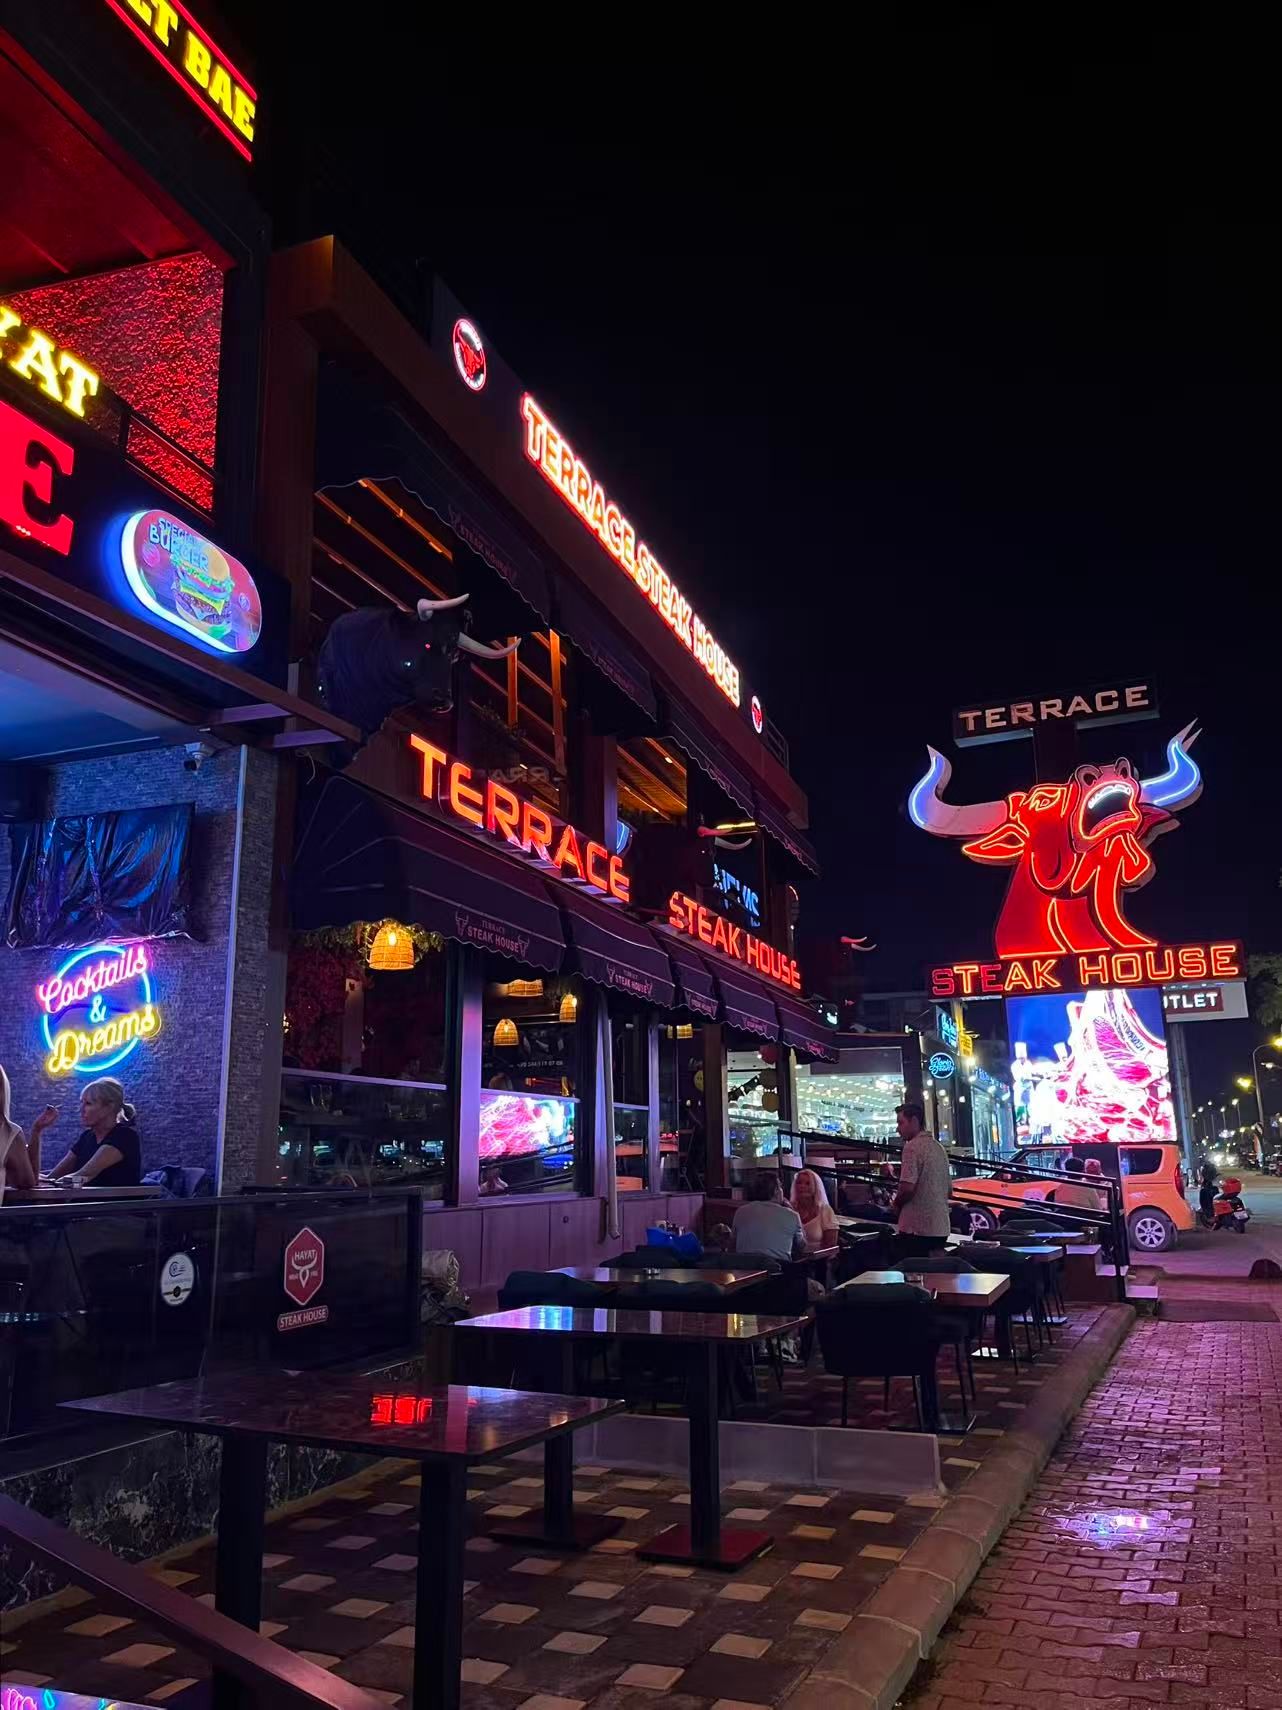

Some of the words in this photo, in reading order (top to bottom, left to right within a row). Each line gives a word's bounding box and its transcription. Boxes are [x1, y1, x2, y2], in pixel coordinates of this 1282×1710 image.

[184, 30, 256, 143] BAE
[521, 393, 635, 575] TERRACE
[635, 541, 693, 651] STEAK
[692, 613, 740, 709] HOUSE
[959, 685, 1149, 731] TERRACE
[410, 733, 630, 902] TERRACE
[467, 926, 493, 944] STEAK
[494, 934, 519, 953] HOUSE
[669, 890, 742, 959] STEAK
[746, 933, 802, 990] HOUSE
[39, 946, 148, 1014] Cocktails
[932, 959, 1061, 996] STEAK
[1079, 945, 1240, 986] HOUSE
[90, 994, 106, 1023] &
[48, 1004, 156, 1073] Dreams
[294, 1250, 317, 1262] HAYAT
[279, 1314, 302, 1328] STEAK
[302, 1308, 328, 1322] HOUSE
